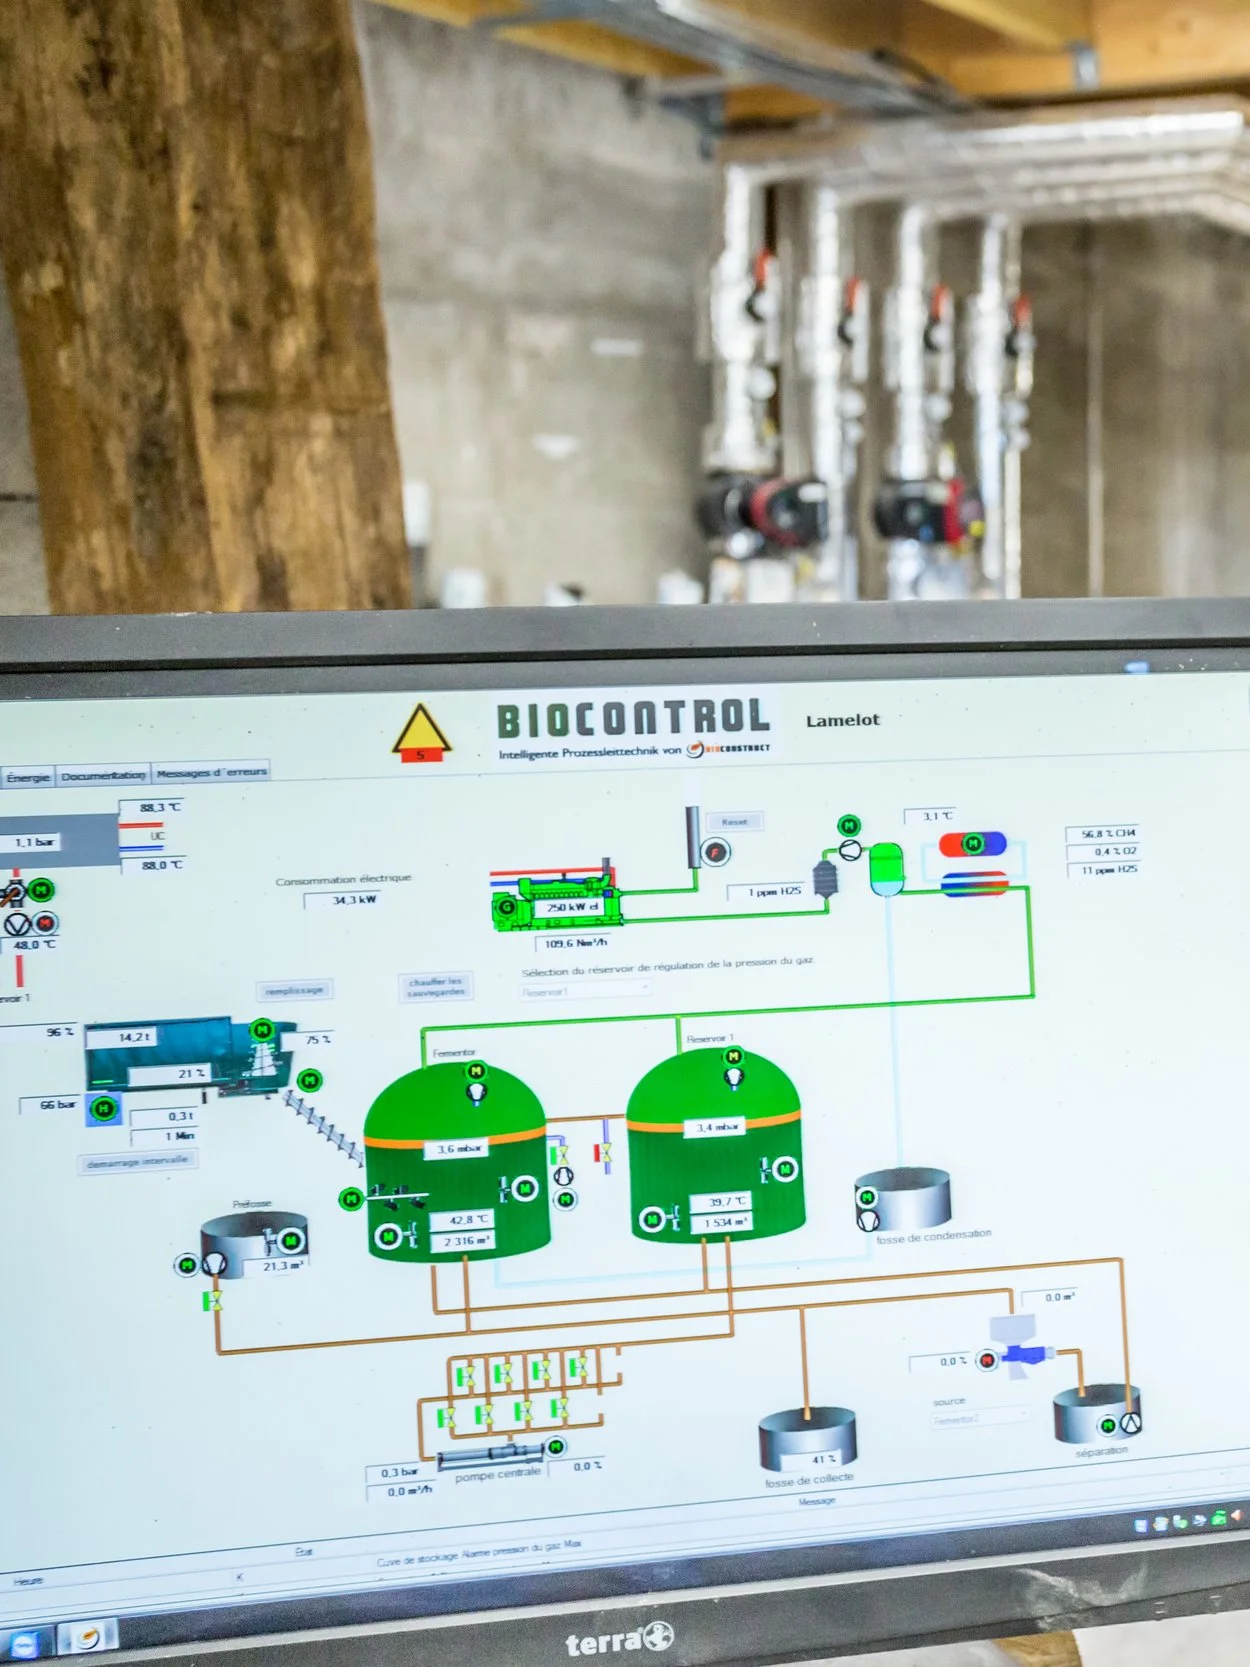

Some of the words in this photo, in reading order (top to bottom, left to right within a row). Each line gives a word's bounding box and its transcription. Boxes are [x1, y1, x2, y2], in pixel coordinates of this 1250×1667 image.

[497, 698, 771, 739] BIOCONTROL
[806, 711, 881, 729] Lamelot
[499, 748, 559, 762] Intelligente
[562, 745, 659, 758] Prozessleittechnik
[662, 746, 682, 755] von
[62, 770, 146, 782] Documentation
[157, 768, 210, 780] Messages
[36, 837, 54, 847] bar
[276, 876, 356, 887] Consommation
[360, 873, 412, 885] électrique
[757, 889, 778, 899] ppm
[781, 886, 802, 895] H2S
[359, 895, 377, 904] kW
[568, 902, 586, 911] kW
[522, 967, 569, 978] Sélection
[572, 965, 585, 975] du
[638, 963, 650, 972] de
[654, 960, 704, 972] régulation
[707, 960, 720, 969] de
[723, 959, 732, 968] la
[736, 957, 777, 969] pression
[780, 956, 793, 965] du
[796, 956, 814, 967] gaz
[57, 1099, 76, 1109] bar
[877, 1235, 905, 1245] fosse
[908, 1233, 921, 1243] de
[924, 1228, 992, 1242] condensation
[401, 1466, 419, 1476] bar
[455, 1472, 495, 1485] pompe
[498, 1467, 541, 1479] centrale
[765, 1478, 794, 1489] fosse
[797, 1476, 810, 1487] de
[813, 1472, 855, 1483] collecte
